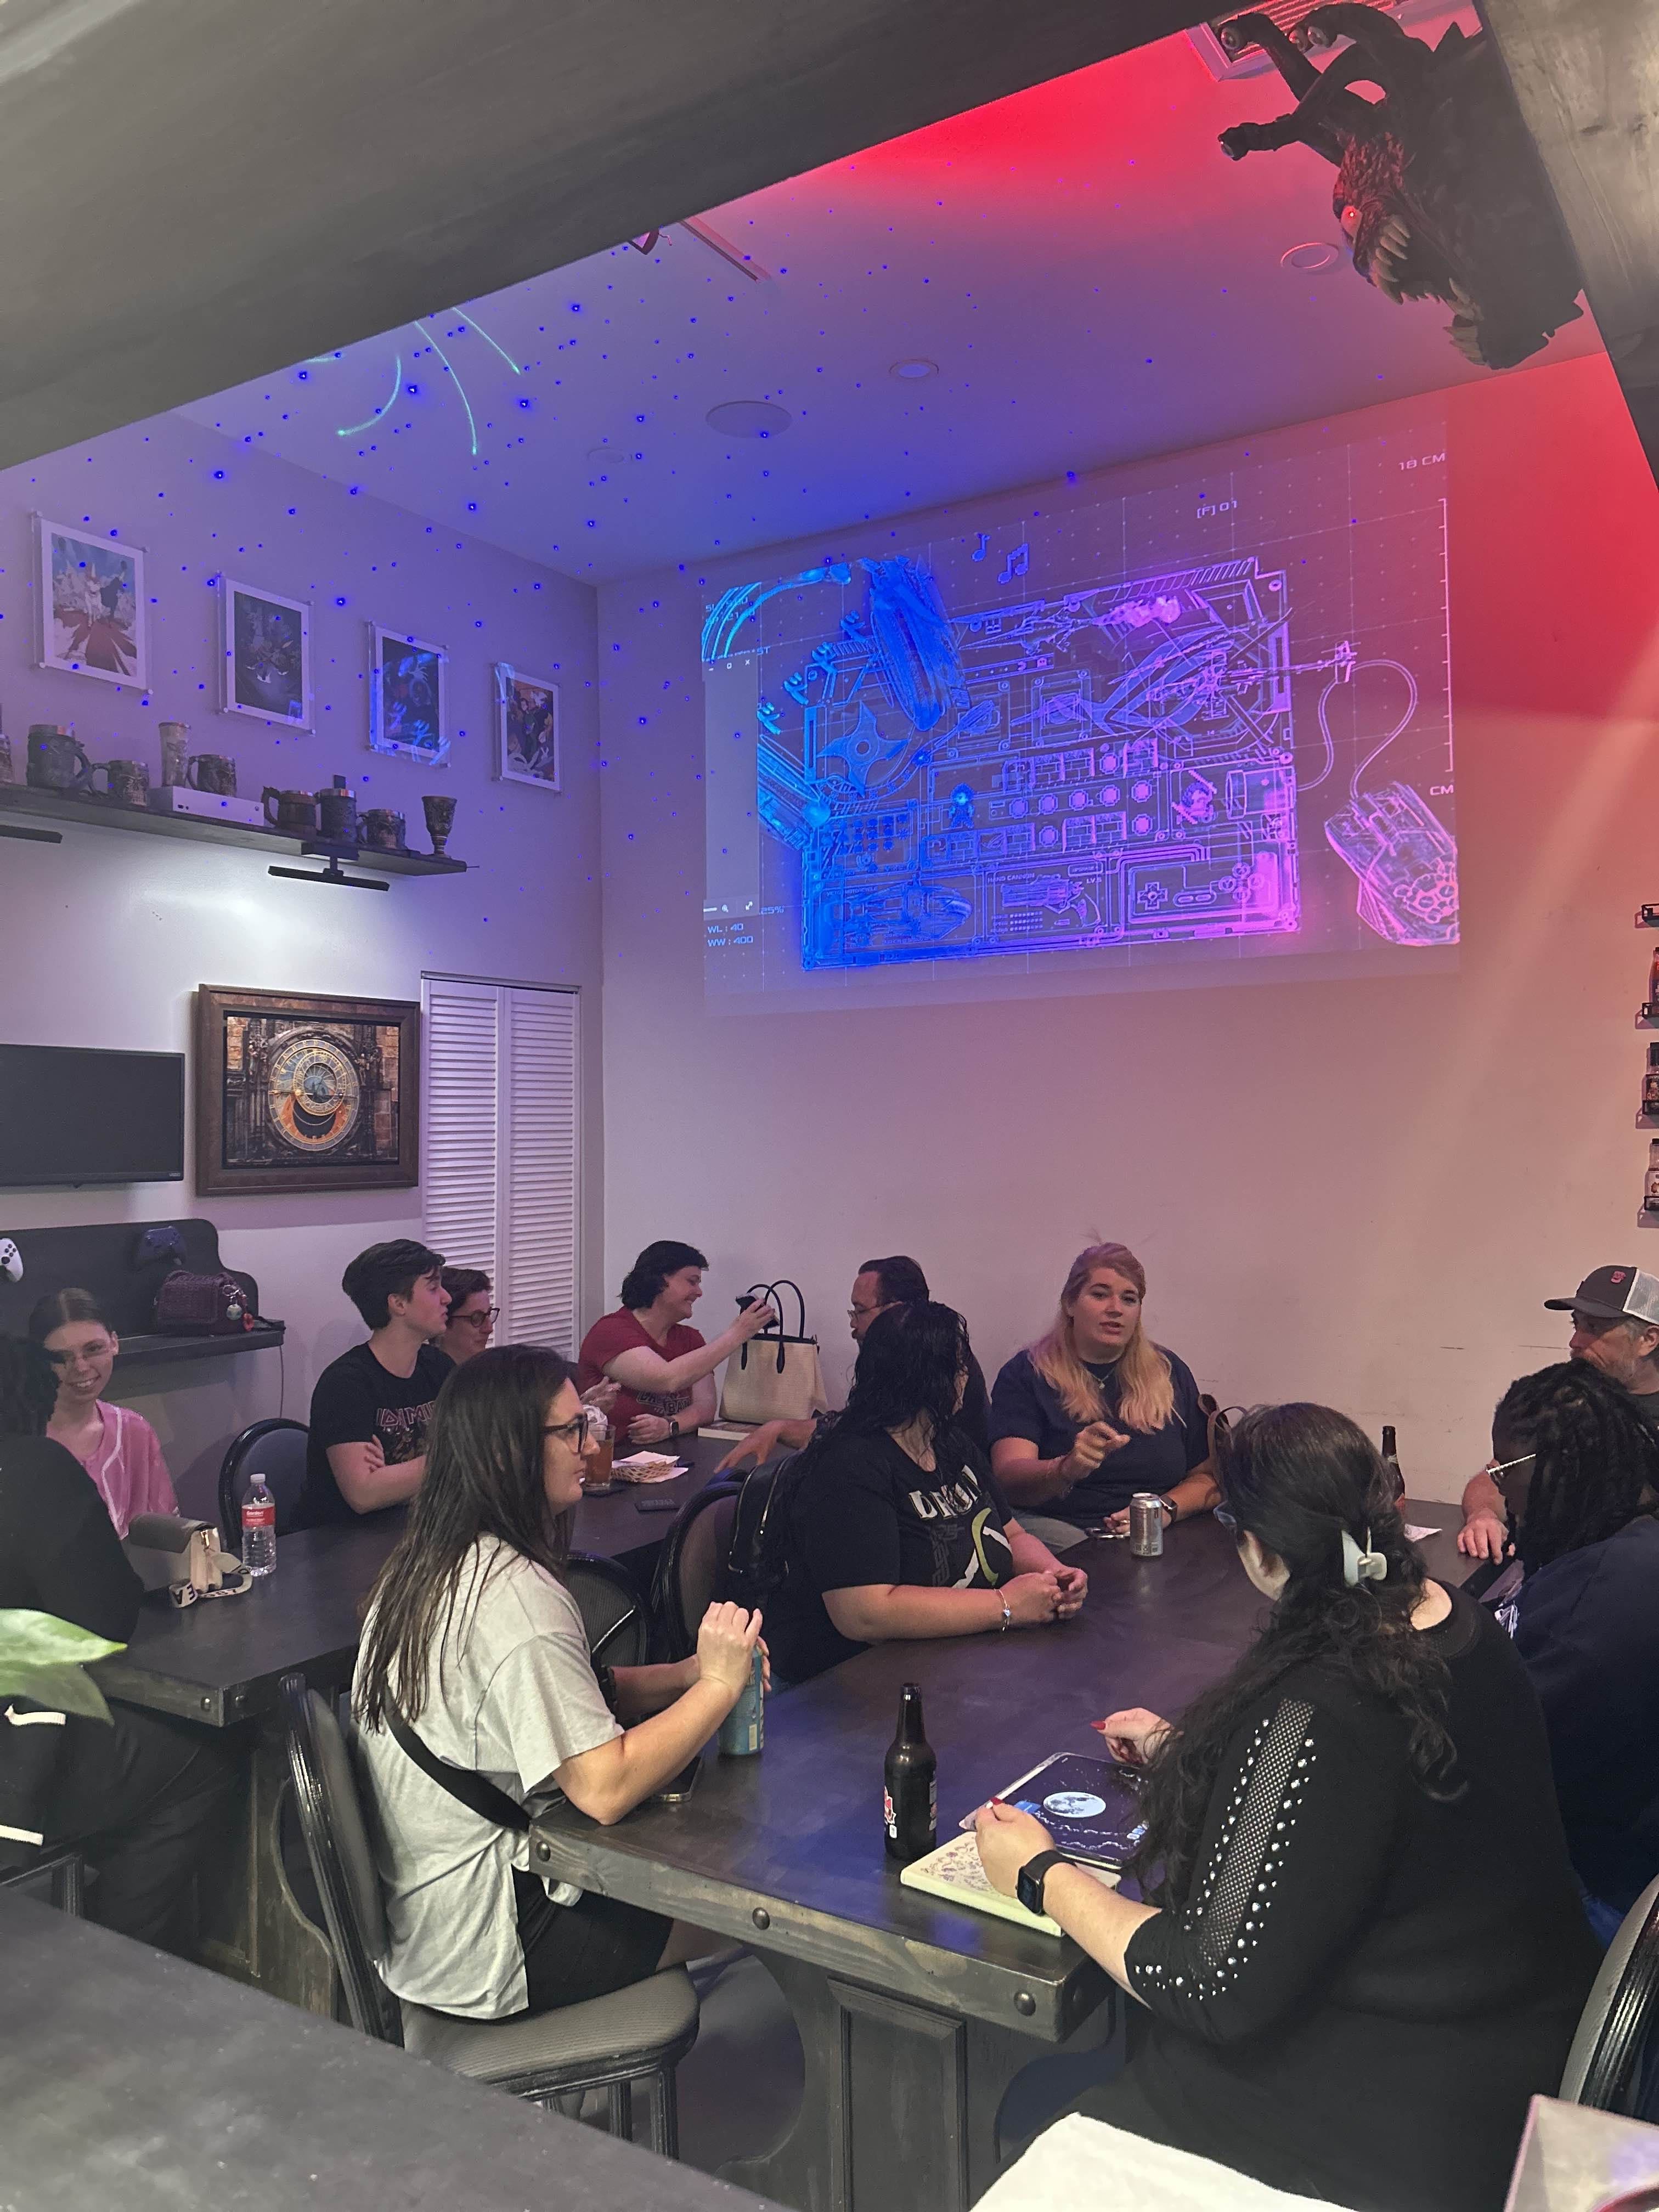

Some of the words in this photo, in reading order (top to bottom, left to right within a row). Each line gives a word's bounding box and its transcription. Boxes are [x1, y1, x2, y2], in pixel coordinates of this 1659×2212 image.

[1398, 459, 1417, 470] 18
[1421, 452, 1445, 465] CM
[1197, 504, 1216, 518] [F]
[1219, 500, 1238, 511] 01
[1430, 785, 1454, 795] CM
[707, 925, 723, 934] WL
[730, 923, 744, 932] 40
[707, 938, 726, 947] WW
[733, 935, 754, 944] 400
